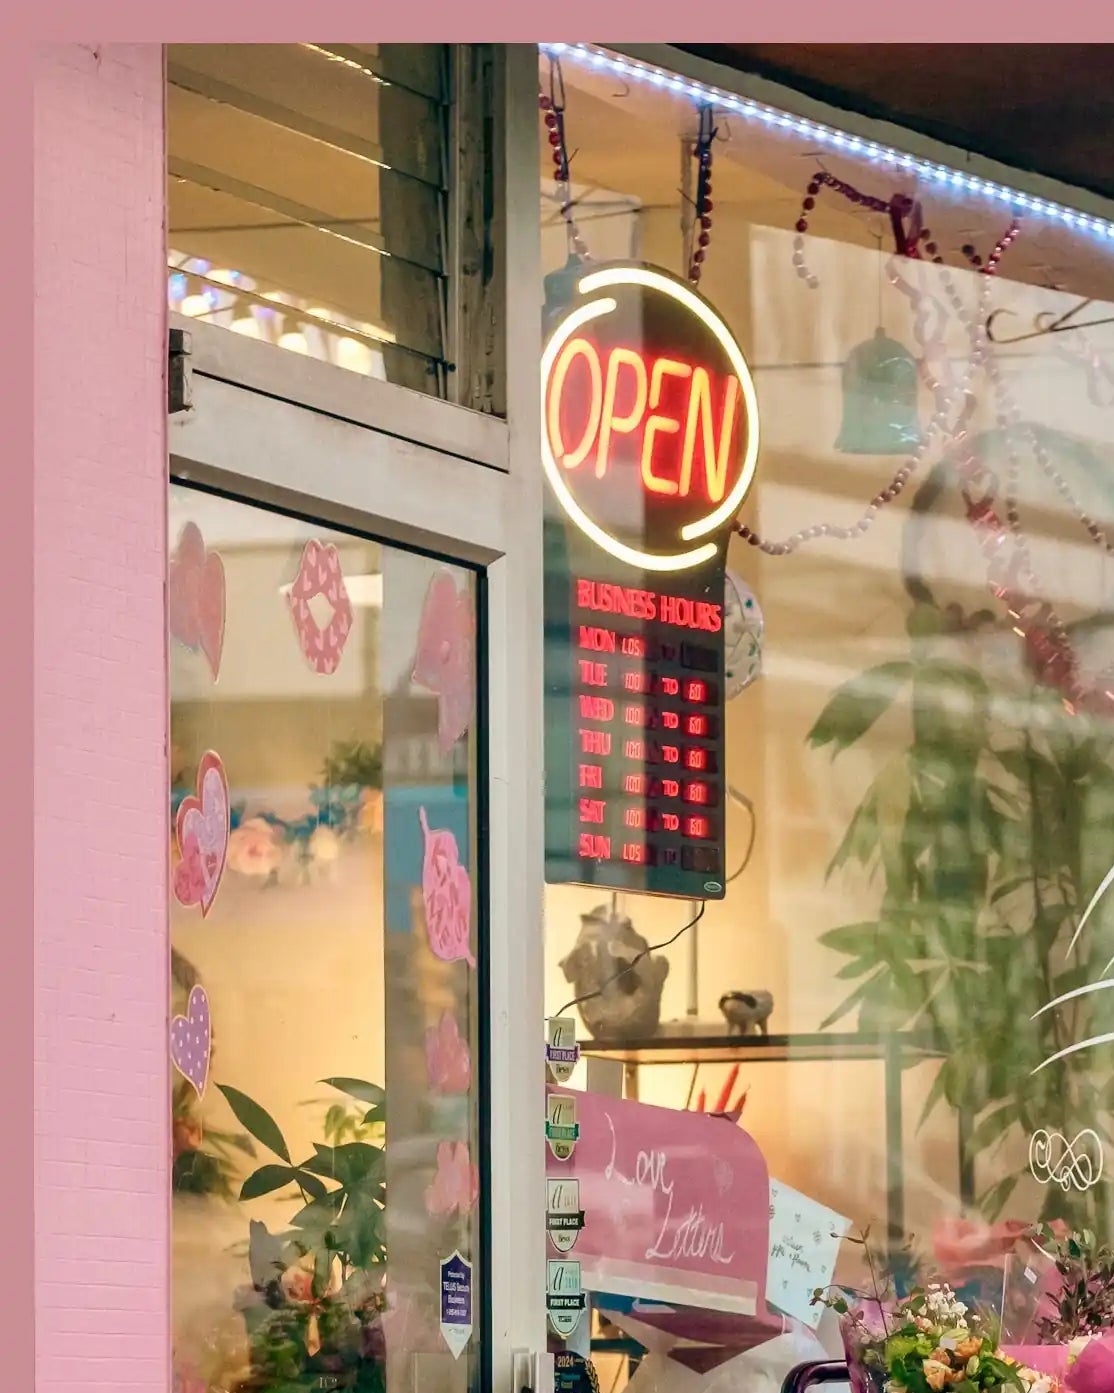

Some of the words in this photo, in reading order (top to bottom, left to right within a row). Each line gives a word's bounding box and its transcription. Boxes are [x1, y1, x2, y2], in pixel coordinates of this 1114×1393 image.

[549, 337, 740, 503] OPEN
[577, 578, 657, 621] BUSINESS
[660, 595, 722, 633] HOURS
[578, 625, 616, 655] MON
[578, 659, 608, 687] TUE
[661, 676, 679, 696] TO
[661, 711, 679, 729] TO
[579, 728, 611, 756] THU
[661, 745, 679, 764] TO
[578, 764, 602, 789] FRI
[661, 779, 679, 798] TO
[579, 798, 606, 824] SAT
[661, 813, 679, 832] TO
[579, 832, 611, 860] SUN
[604, 1112, 674, 1194] Love
[549, 1217, 563, 1226] FIRST
[563, 1217, 579, 1227] PLACE
[645, 1192, 735, 1264] Letters
[550, 1298, 564, 1306] FIRST
[557, 1356, 574, 1368] 2024
